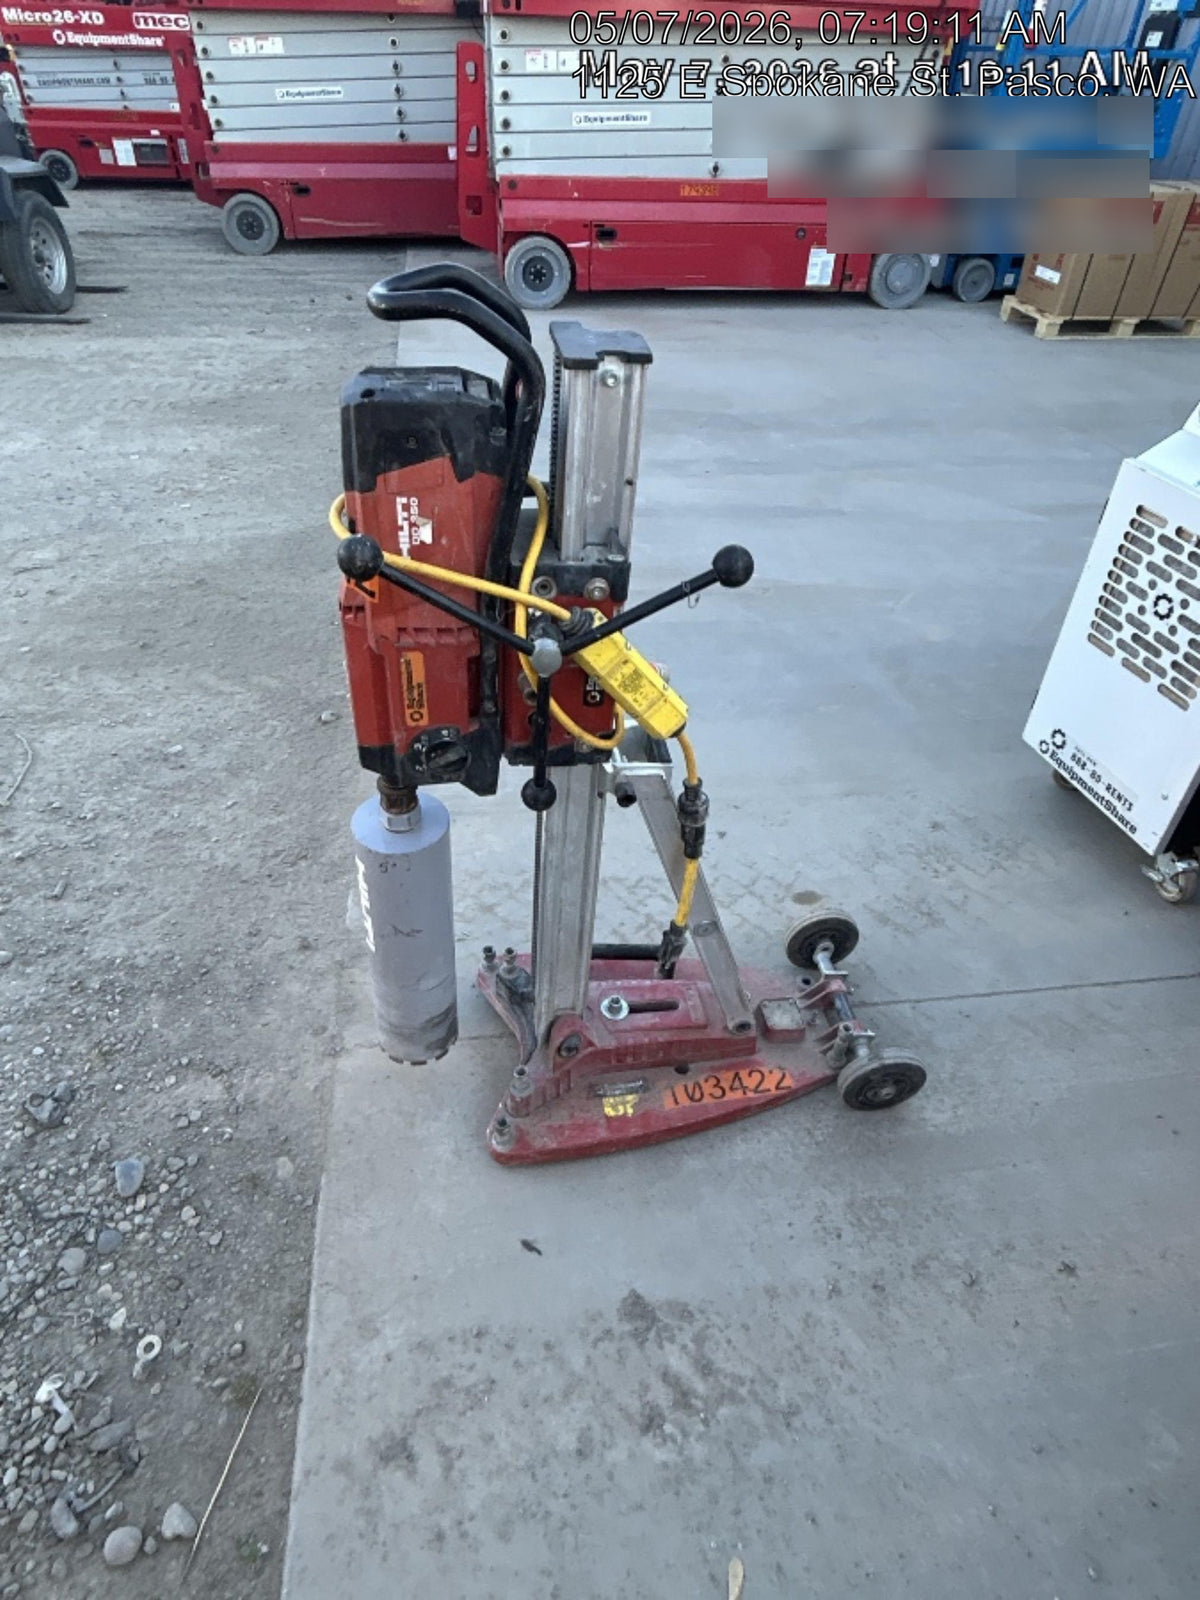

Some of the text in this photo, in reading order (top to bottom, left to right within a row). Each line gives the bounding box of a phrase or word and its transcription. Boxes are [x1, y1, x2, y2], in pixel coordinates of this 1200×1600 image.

[1, 7, 105, 26] Micro26-XD
[135, 14, 190, 29] mec
[66, 31, 163, 47] EquipmentShare
[1048, 749, 1138, 836] EquipmentShare
[669, 1065, 793, 1107] 103422
